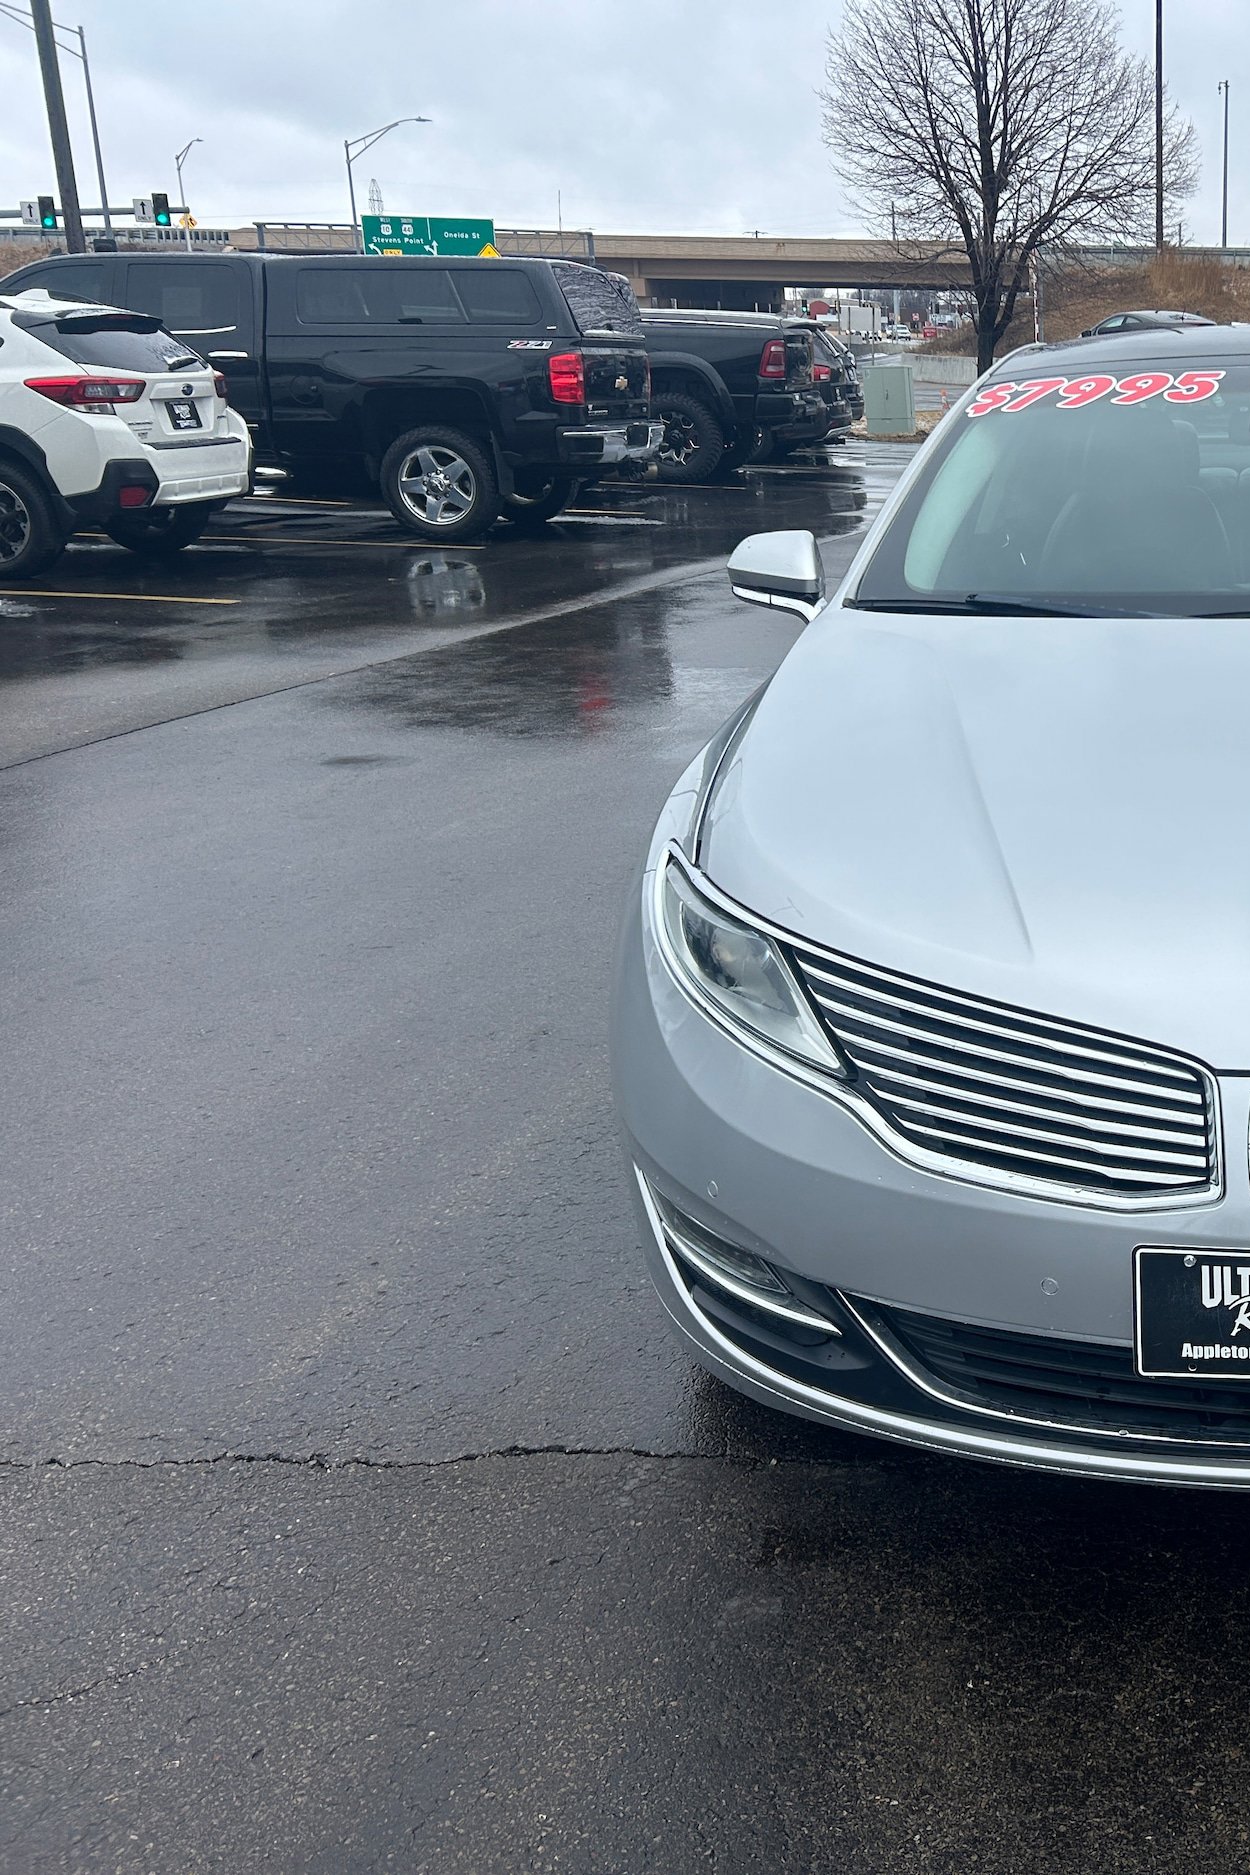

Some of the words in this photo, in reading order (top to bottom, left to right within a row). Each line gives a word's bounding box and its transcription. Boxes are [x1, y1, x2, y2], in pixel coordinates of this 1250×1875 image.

[443, 231, 469, 239] Oneida
[372, 236, 401, 244] Stevens
[506, 340, 553, 350] Z71
[965, 370, 1226, 418] $7995
